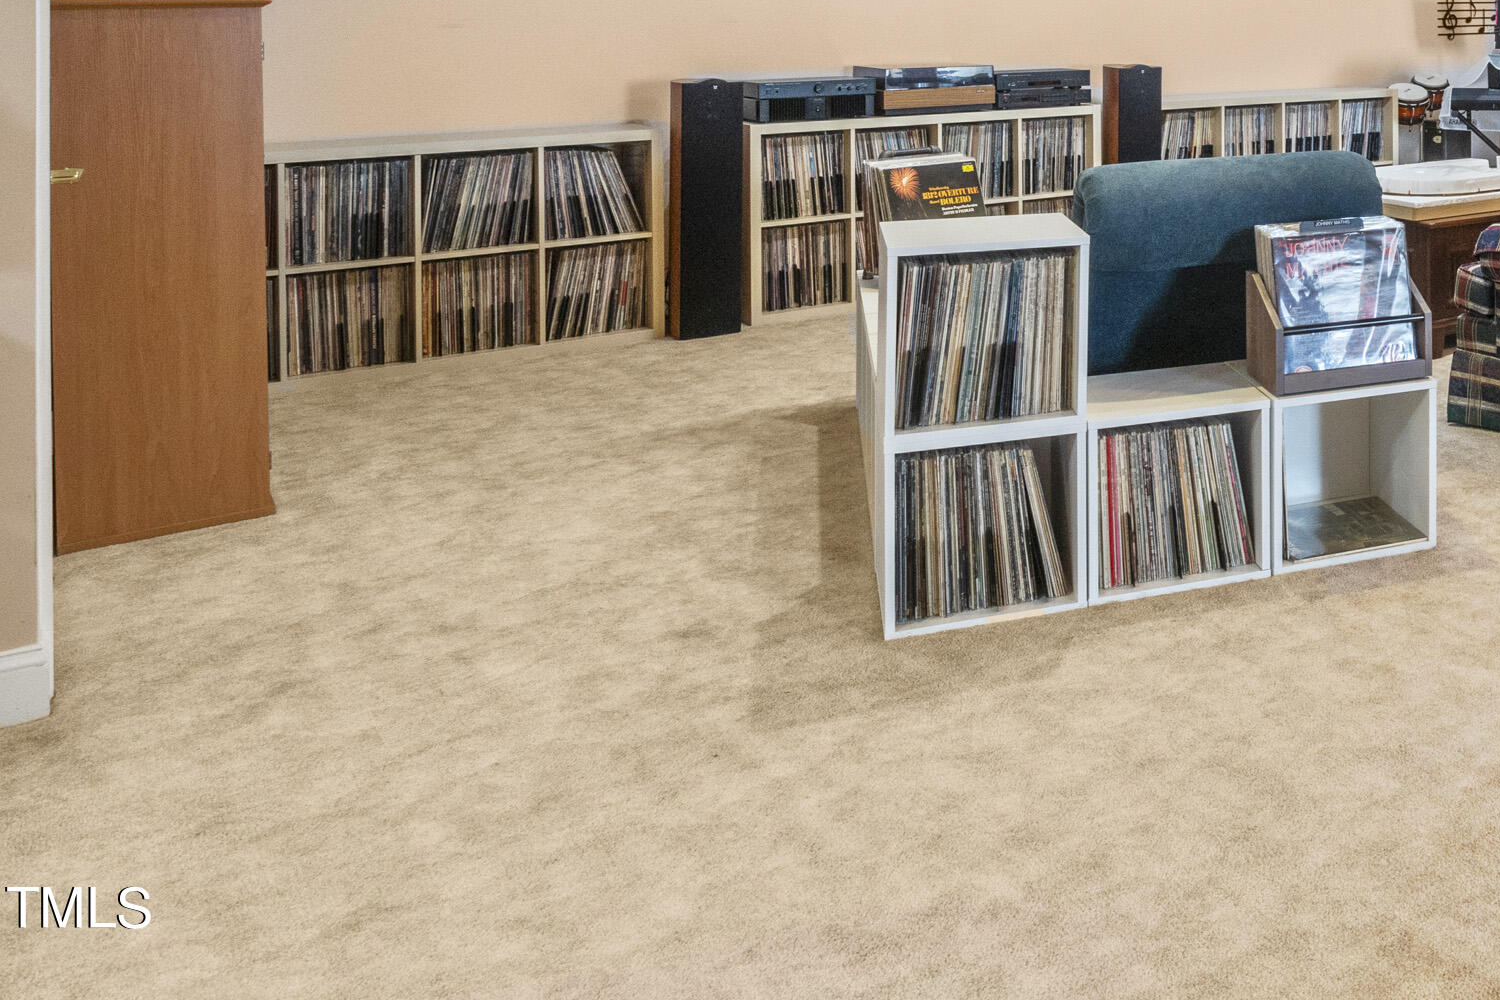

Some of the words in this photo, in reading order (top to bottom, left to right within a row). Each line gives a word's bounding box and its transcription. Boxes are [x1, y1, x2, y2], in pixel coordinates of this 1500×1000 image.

[938, 186, 979, 198] OVERTURE
[940, 195, 972, 206] BOLERO
[1283, 235, 1349, 258] JOHNNY
